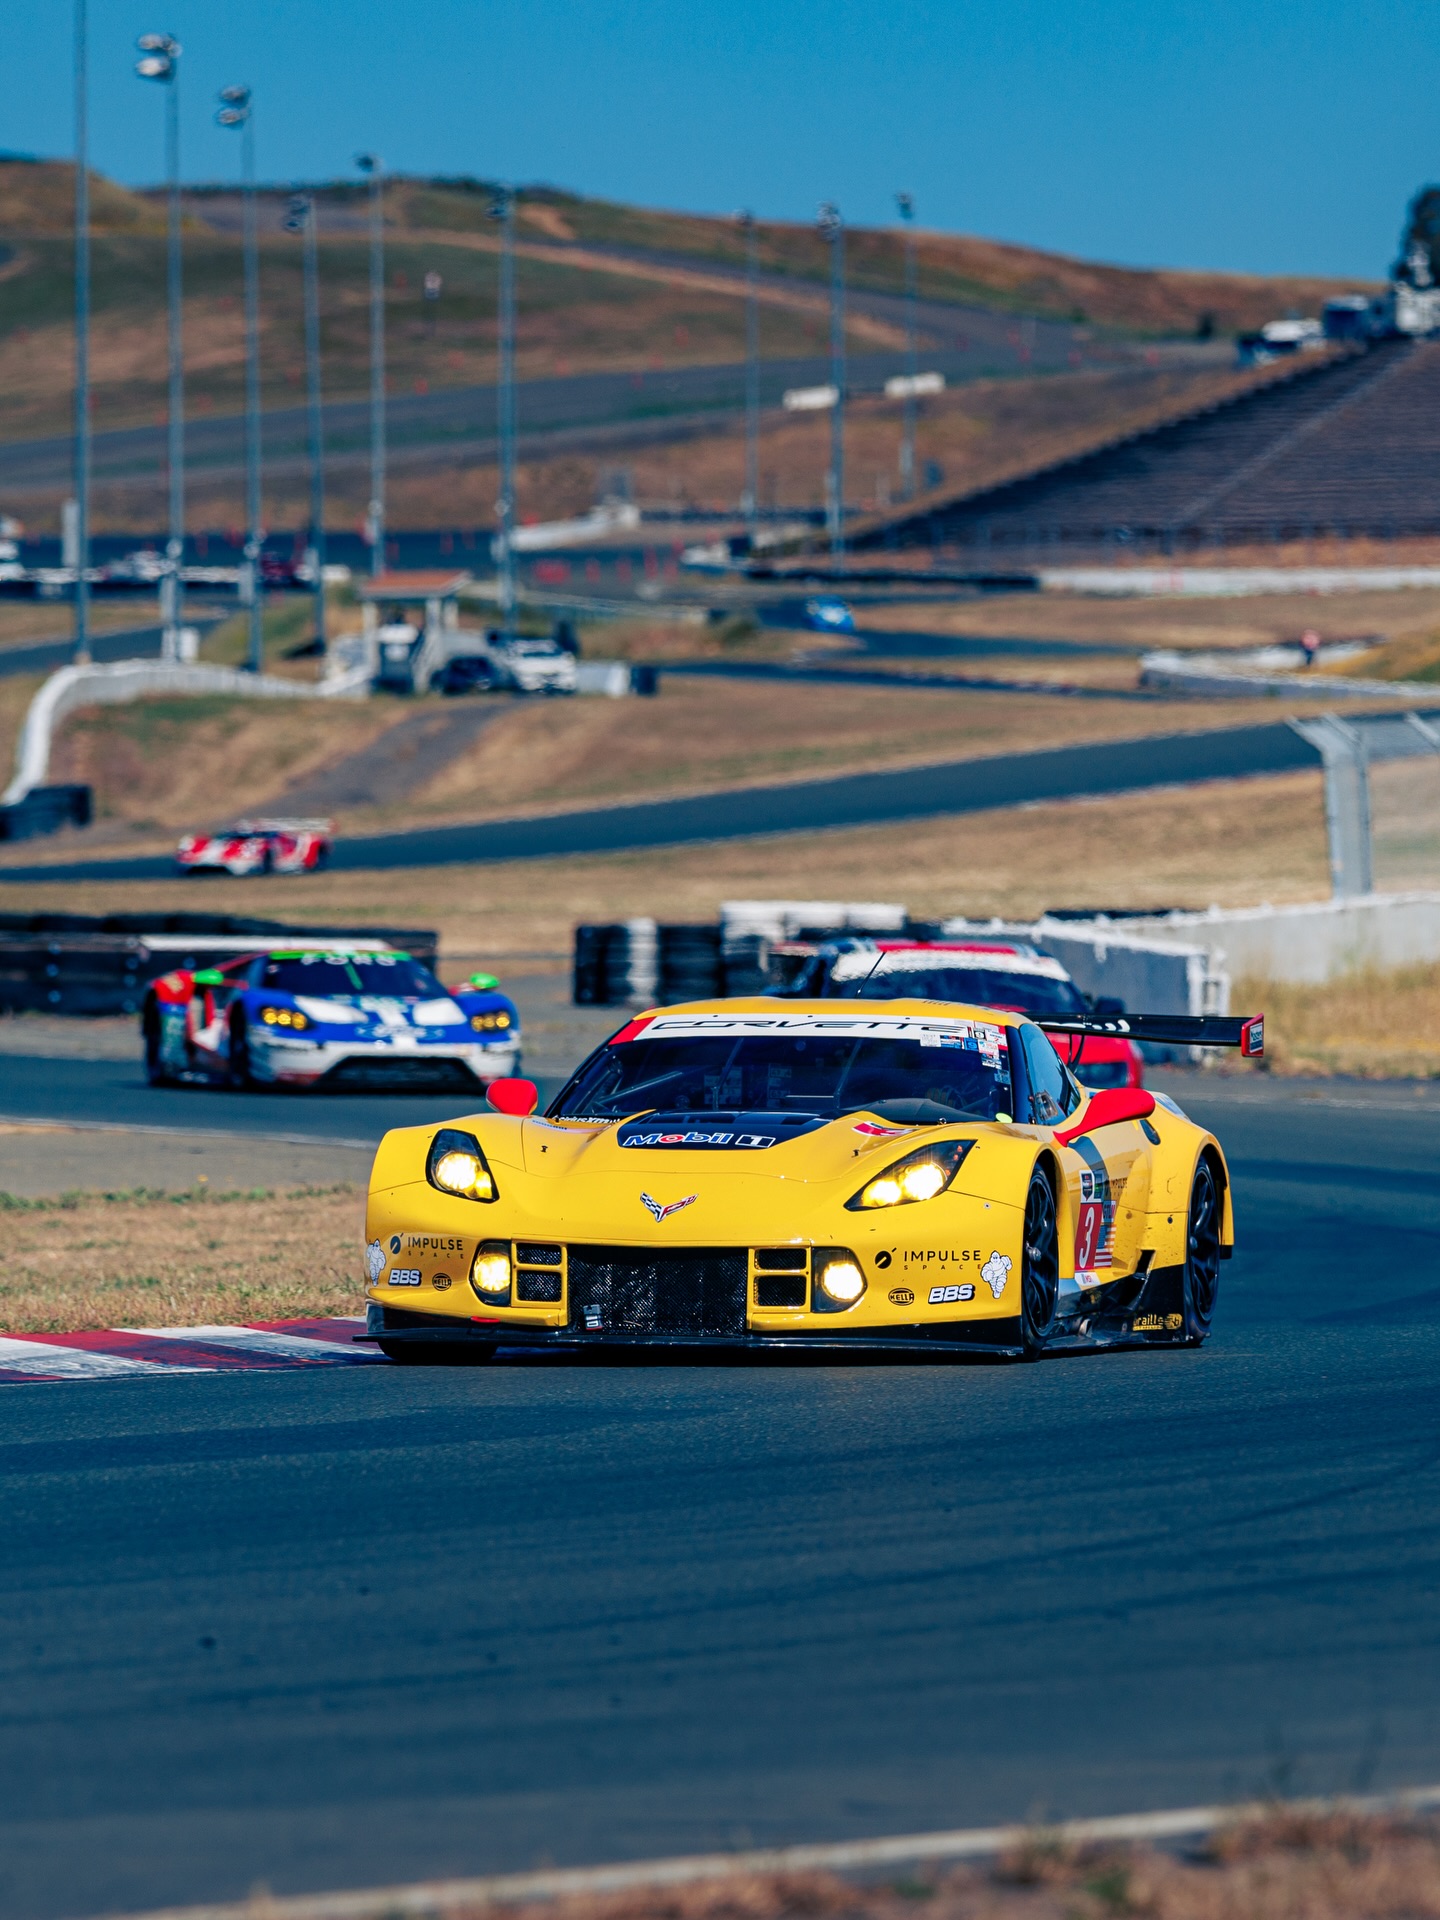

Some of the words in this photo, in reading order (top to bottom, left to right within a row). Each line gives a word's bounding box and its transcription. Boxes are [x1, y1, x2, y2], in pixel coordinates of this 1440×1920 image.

[651, 1020, 966, 1035] CORVETTE
[623, 1131, 733, 1147] Mobil
[407, 1236, 464, 1251] IMPULSE
[1079, 1206, 1095, 1269] 3
[903, 1250, 981, 1262] IMPULSE
[388, 1268, 422, 1287] BBS
[890, 1293, 915, 1302] HELLA
[928, 1283, 975, 1304] BBS
